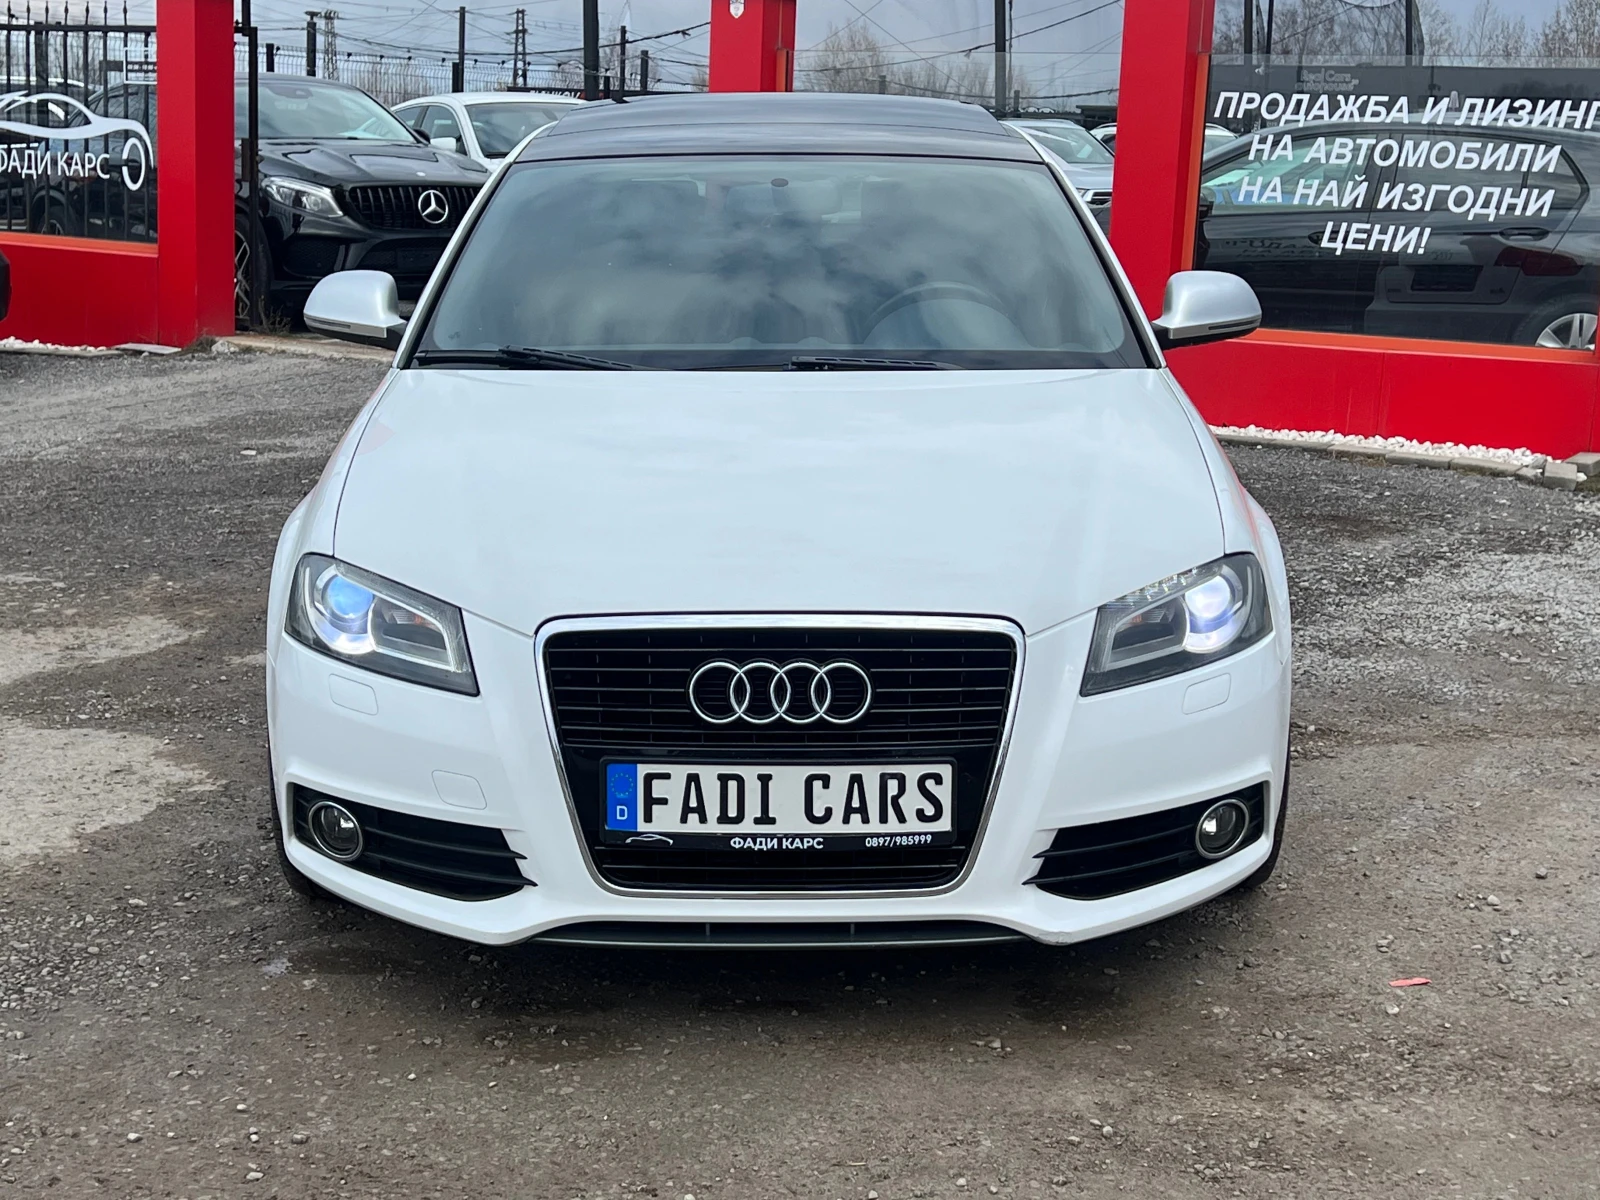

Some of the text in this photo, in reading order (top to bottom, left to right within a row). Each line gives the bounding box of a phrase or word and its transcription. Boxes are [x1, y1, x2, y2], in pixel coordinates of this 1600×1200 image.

[1214, 91, 1409, 128] ПРОДАЖБА
[1421, 96, 1450, 125] И
[57, 151, 110, 179] КАРС
[1248, 134, 1562, 173] НА АВТОМОБИЛИ
[1238, 174, 1555, 222] НА НАЙ ИЗГОДНИ
[1321, 220, 1431, 256] ЦЕНИ!
[616, 805, 628, 820] D
[643, 772, 943, 825] FADI CARS
[730, 837, 824, 851] ФАДИ КАРС
[865, 834, 932, 848] 0897/985999
